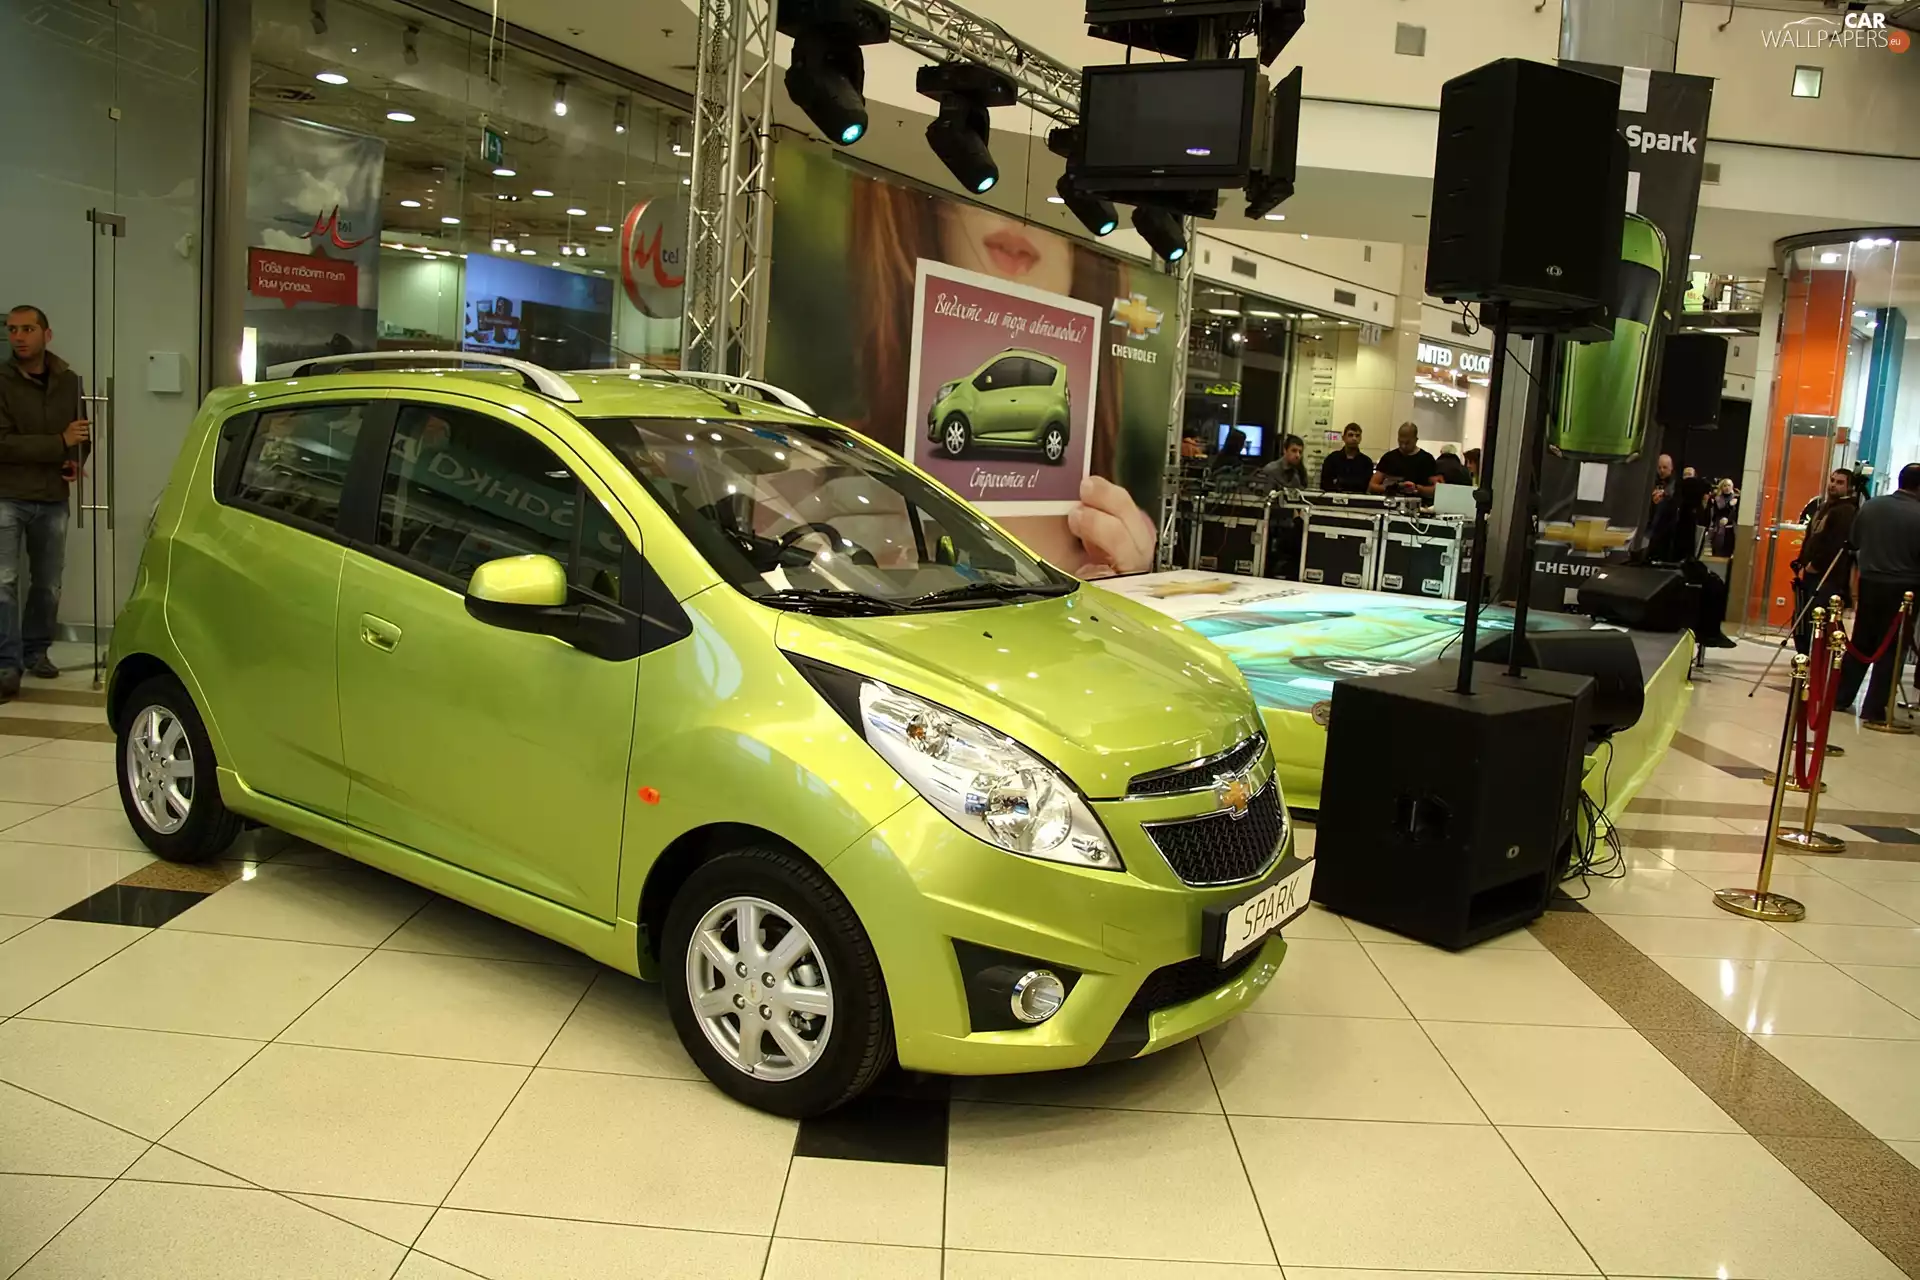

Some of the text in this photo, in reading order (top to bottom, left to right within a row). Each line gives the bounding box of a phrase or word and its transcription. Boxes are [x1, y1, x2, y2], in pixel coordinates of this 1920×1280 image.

[1625, 124, 1698, 154] Spark
[1111, 343, 1157, 364] CHEVROLET
[1242, 876, 1299, 941] SPARK
